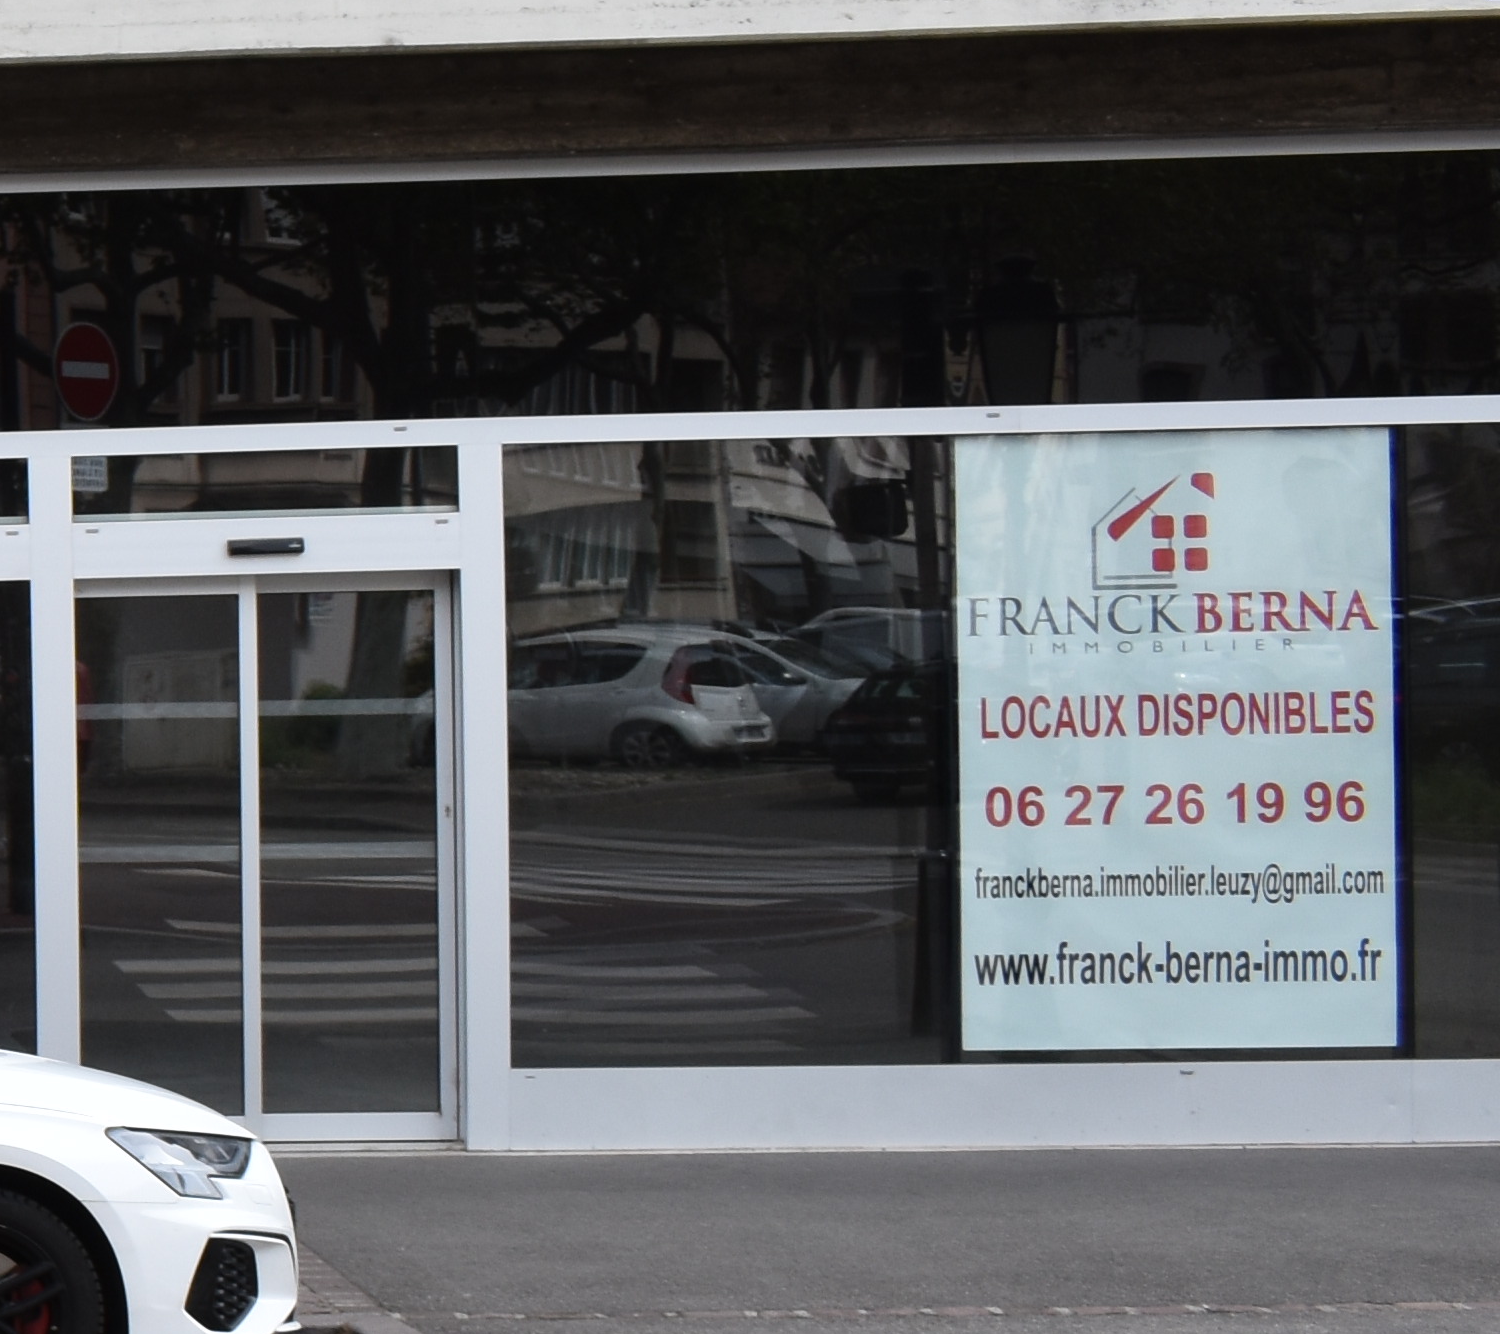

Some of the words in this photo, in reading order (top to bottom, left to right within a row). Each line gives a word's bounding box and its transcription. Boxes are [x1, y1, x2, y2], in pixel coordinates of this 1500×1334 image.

[966, 593, 1187, 637] FRANCK
[1192, 589, 1380, 634] BERNA
[1029, 637, 1295, 655] IMMOBILIER
[980, 694, 1128, 740] LOCAUX
[1137, 689, 1375, 737] DISPONIBLES
[984, 784, 1047, 828] 06
[1063, 784, 1126, 827] 27
[1143, 782, 1206, 826] 26
[1225, 781, 1286, 825] 19
[1302, 779, 1367, 824] 96
[974, 862, 1386, 905] franckberna.immobilier.leuzy@gmail.com
[974, 937, 1383, 986] www.franck-berna-immo.fr
